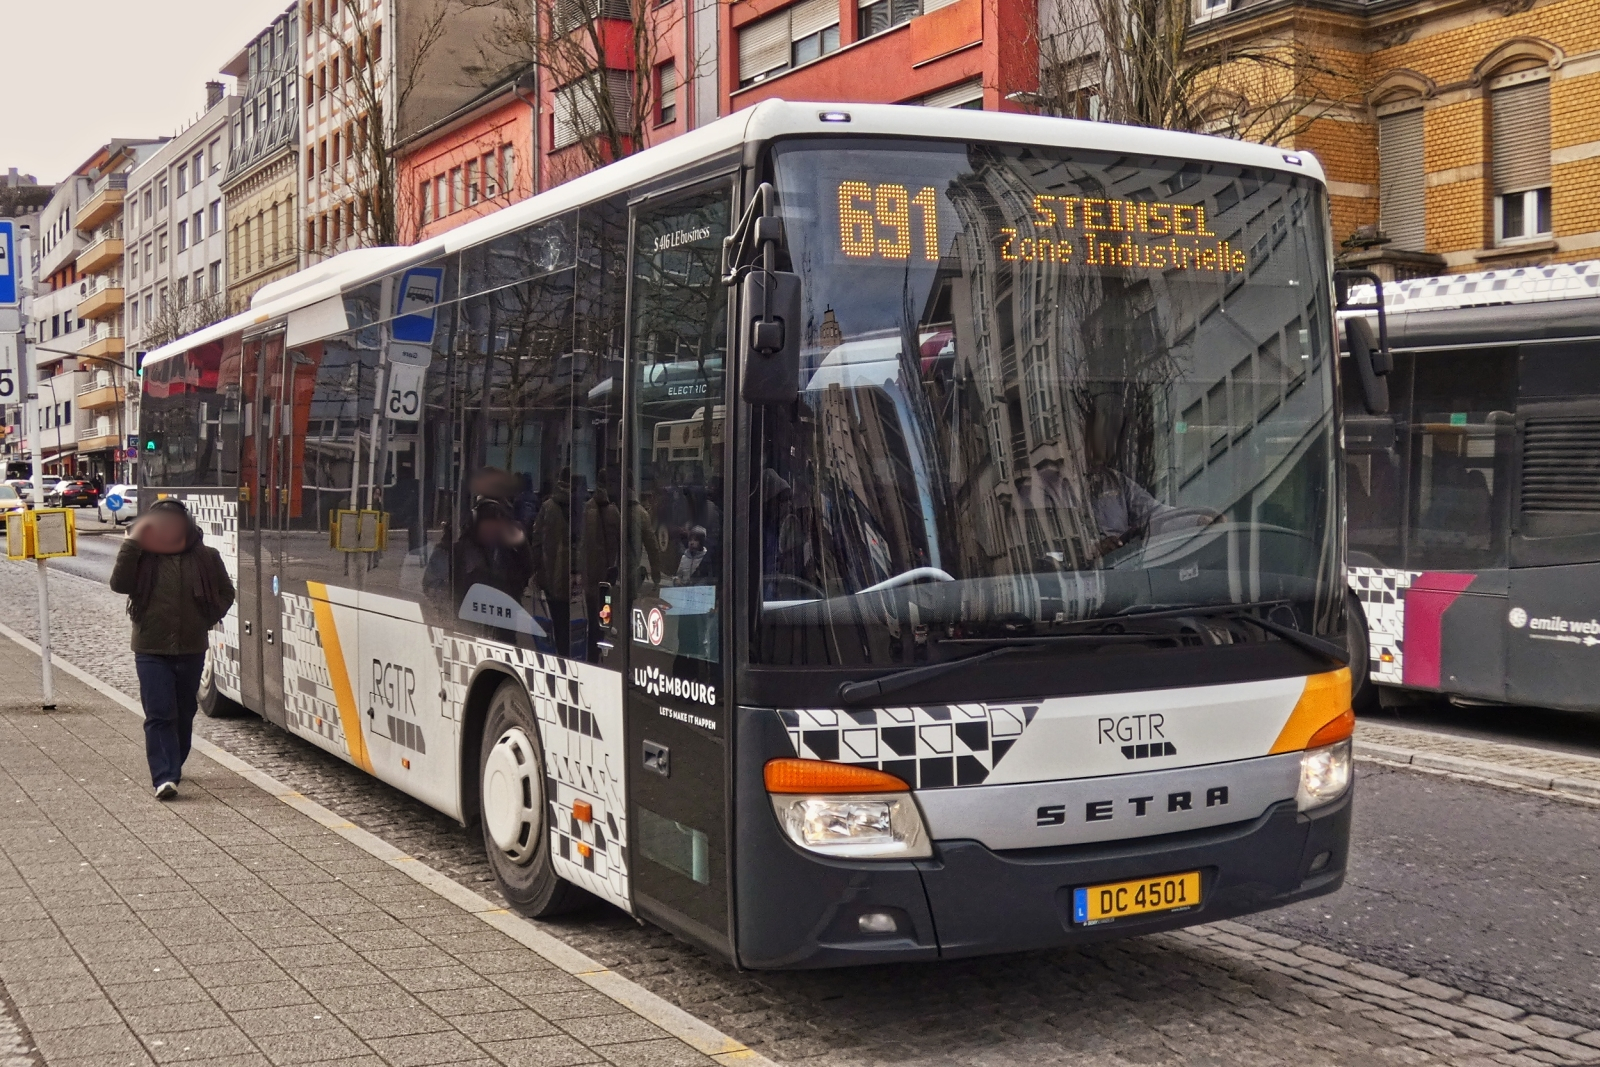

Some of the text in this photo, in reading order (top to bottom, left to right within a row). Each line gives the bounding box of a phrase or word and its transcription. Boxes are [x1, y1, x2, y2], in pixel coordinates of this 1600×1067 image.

[838, 181, 939, 260] 691
[1033, 194, 1215, 237] STEINSEL
[654, 226, 710, 252] S 416 LE business
[1001, 227, 1247, 272] Zone Industrielle
[472, 601, 512, 618] SETRA
[1530, 616, 1600, 634] emile web
[372, 658, 416, 716] RGTR
[634, 665, 716, 705] LUXEMBOURG
[659, 706, 716, 730] LET'S MAKE IT HAPPEN
[1098, 713, 1165, 745] RGTR
[1036, 786, 1229, 826] SETRA
[1078, 907, 1084, 917] L
[1100, 878, 1187, 914] DC 4501
